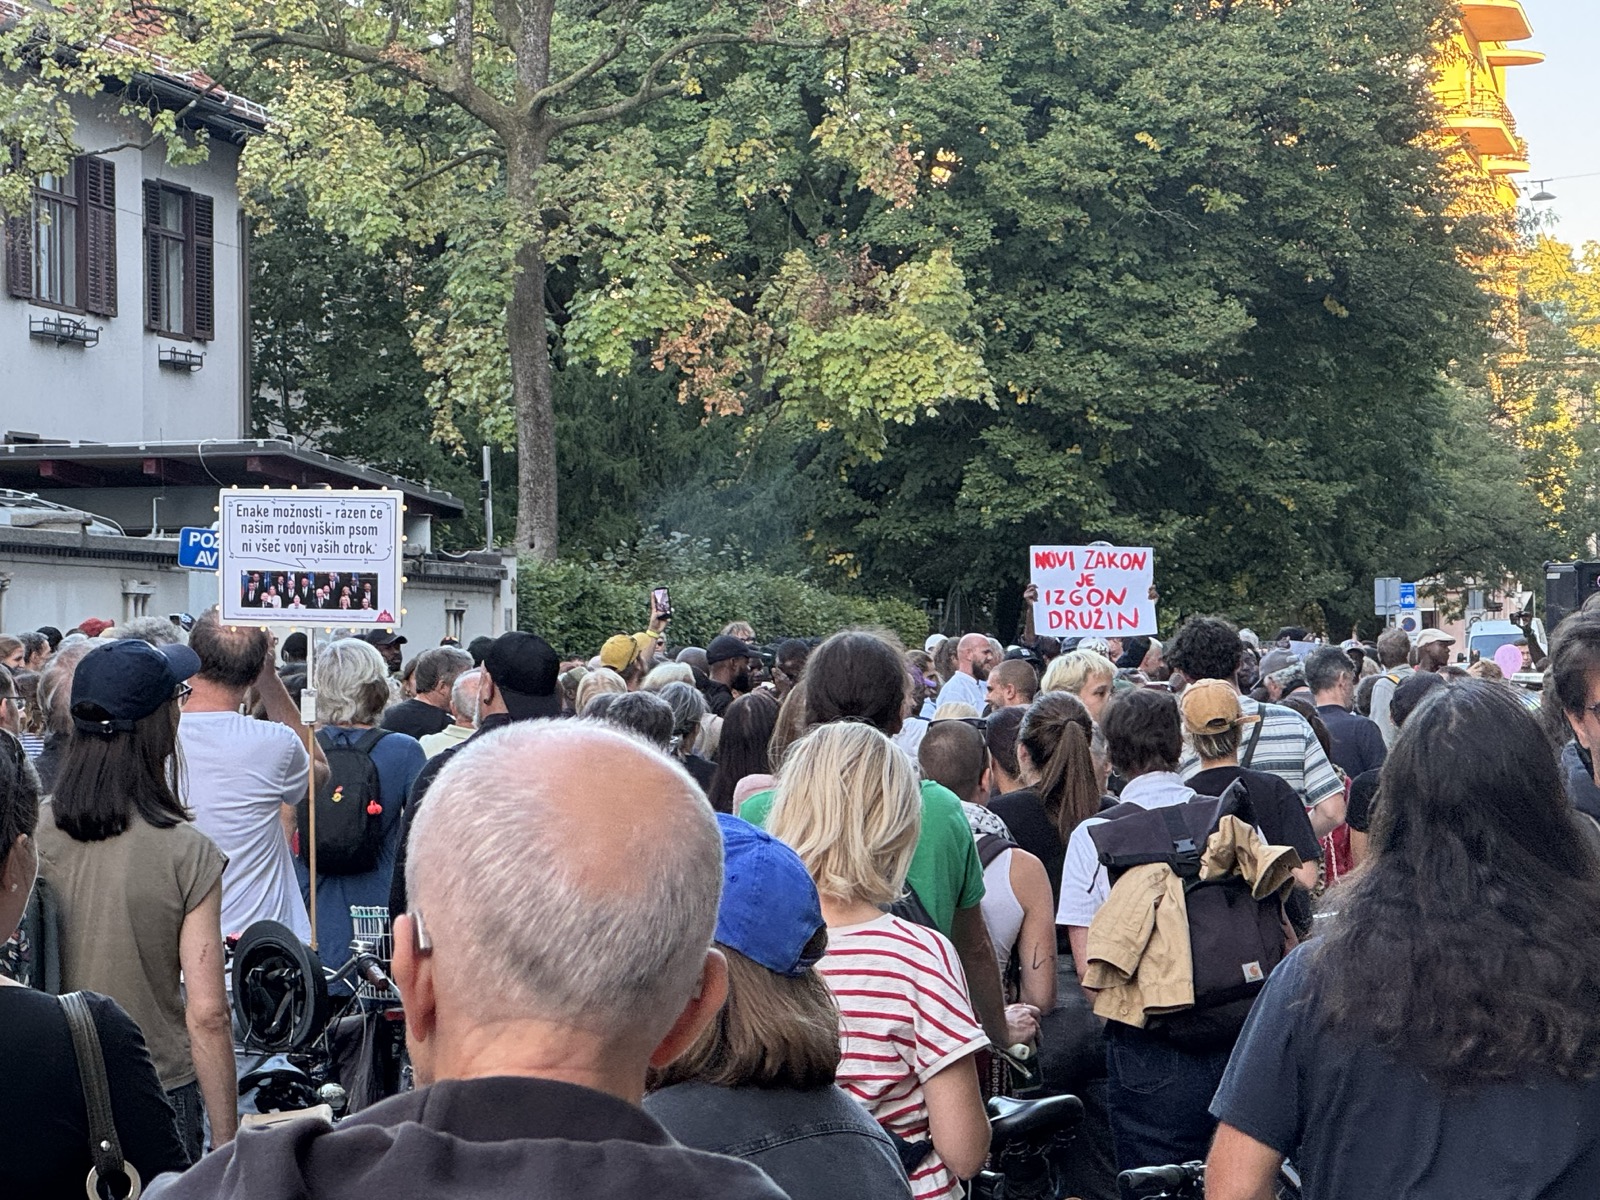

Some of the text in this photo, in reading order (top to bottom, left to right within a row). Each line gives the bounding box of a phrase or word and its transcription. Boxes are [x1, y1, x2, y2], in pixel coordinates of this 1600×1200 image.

[236, 503, 269, 518] Enake
[273, 503, 322, 518] možnosti
[335, 508, 366, 519] razen
[370, 504, 383, 519] če
[241, 519, 378, 539] našim rodovniškim psom
[242, 538, 252, 552] ni
[255, 538, 281, 553] všeč
[284, 539, 307, 557] vonj
[310, 539, 340, 554] vaših
[1034, 549, 1147, 571] NOVI ZAKON
[1075, 573, 1096, 588] JE
[1045, 587, 1128, 608] IZGON
[1048, 607, 1140, 631] DRUŽIN
